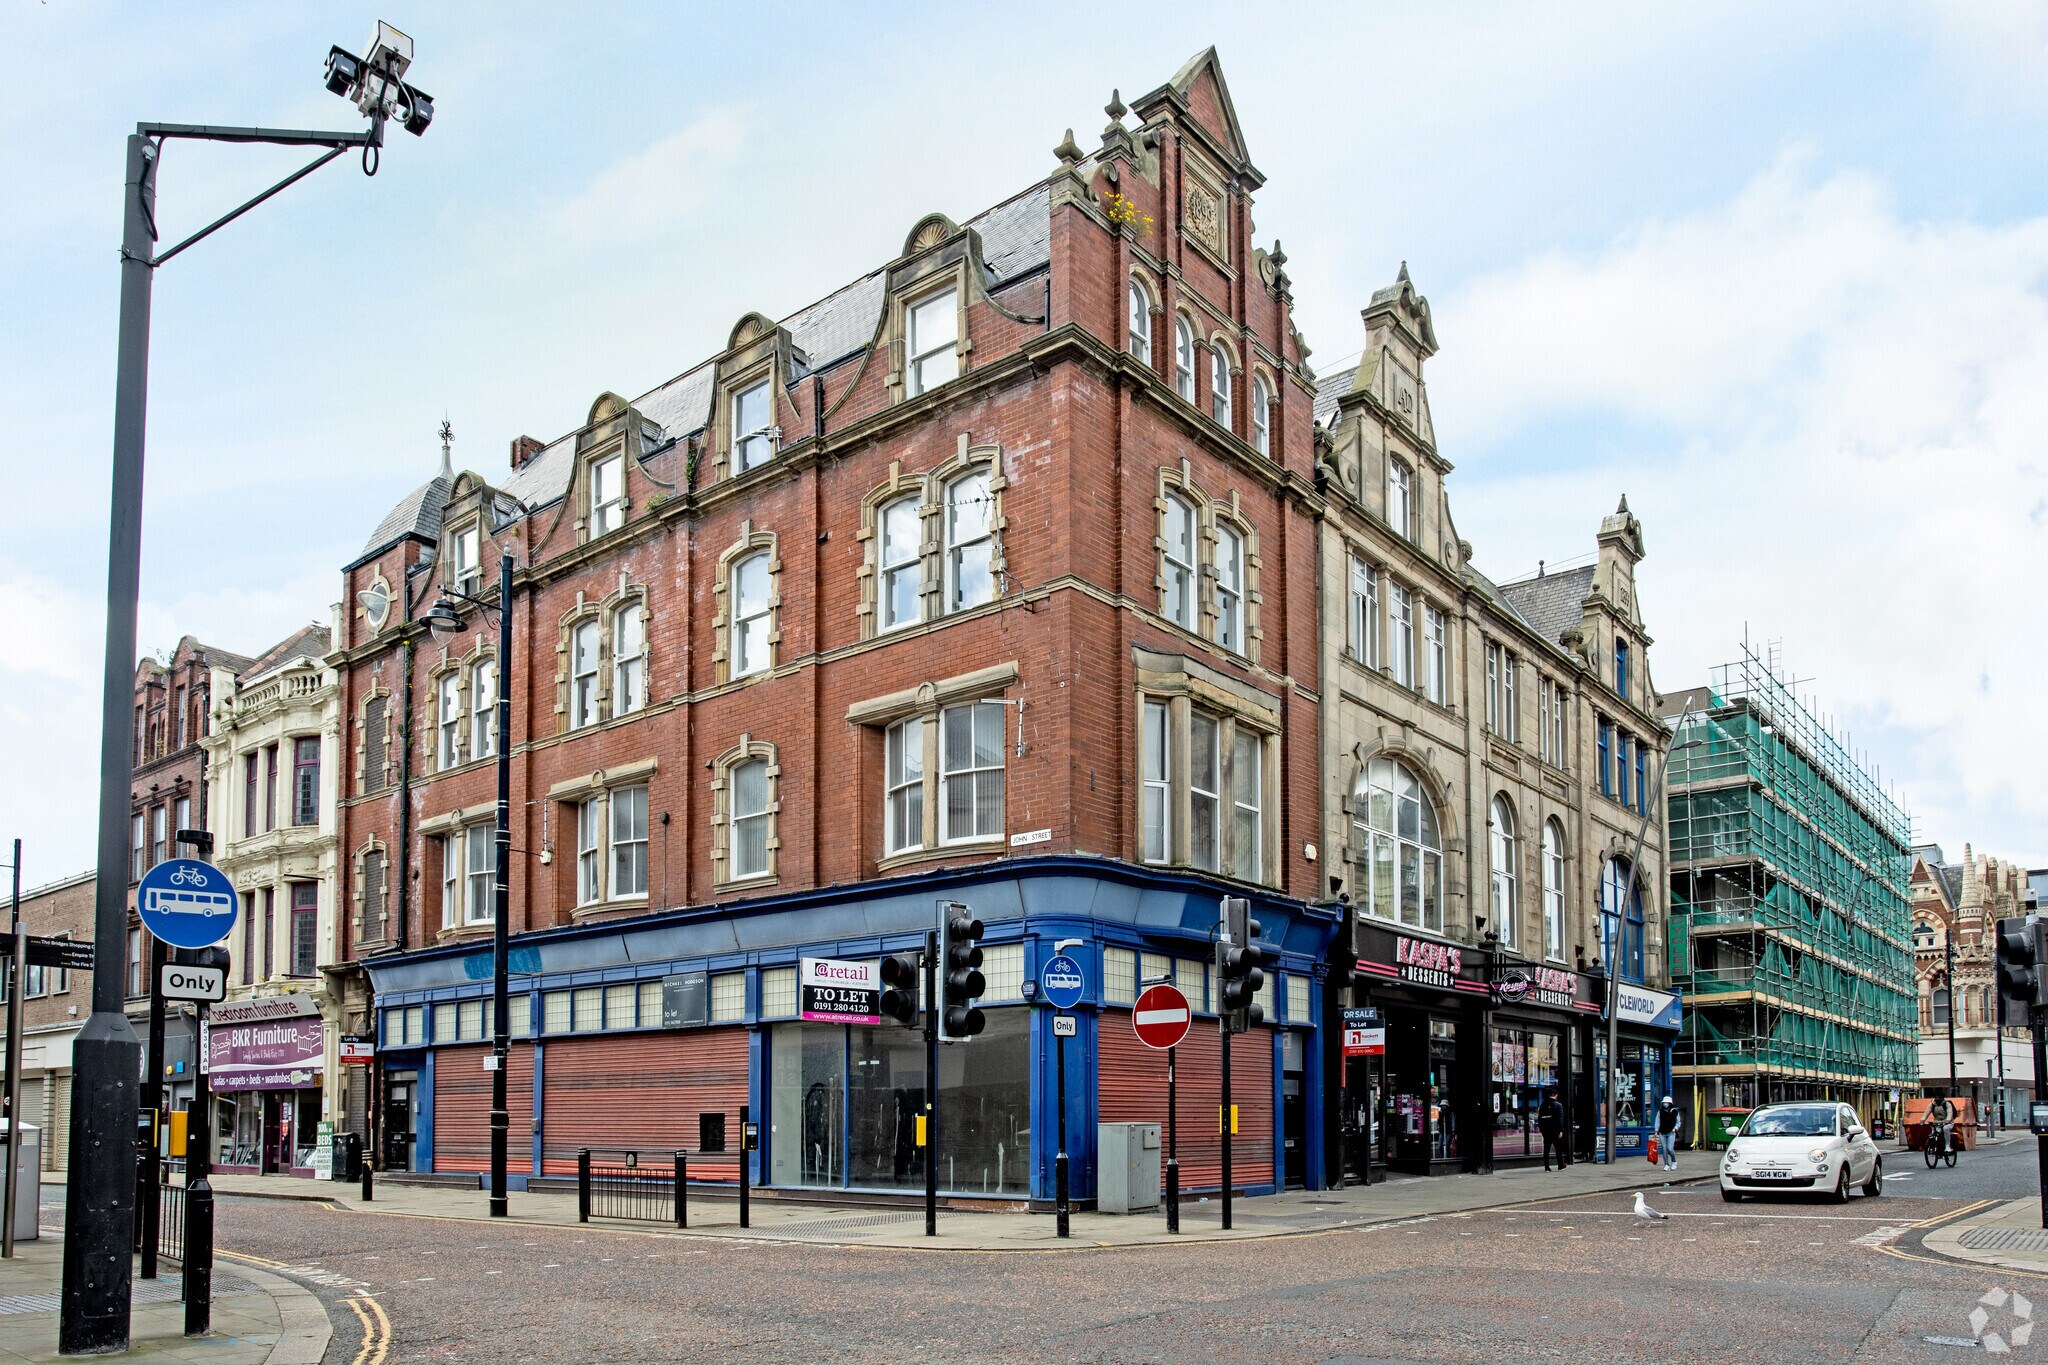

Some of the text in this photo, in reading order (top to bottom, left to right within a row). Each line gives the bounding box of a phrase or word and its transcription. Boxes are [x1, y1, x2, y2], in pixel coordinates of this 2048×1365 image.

[1013, 832, 1051, 844] JOHN STREET
[1671, 916, 1684, 975] CYCLES
[1396, 936, 1461, 974] KASPA'S
[816, 964, 869, 980] @retail
[1408, 966, 1448, 986] DESSERTS
[170, 974, 215, 992] Only
[814, 988, 869, 1003] TO LET
[1540, 990, 1568, 1006] DESSERTS
[211, 1000, 299, 1021] bedroom furniture
[814, 1002, 832, 1010] 0191
[813, 1013, 869, 1022] www.atretail.co.uk
[1056, 1021, 1073, 1031] Only
[232, 1025, 298, 1047] BKR Furniture
[214, 1073, 291, 1087] sofas carpets beds wardrobes
[317, 1135, 332, 1146] BEDS
